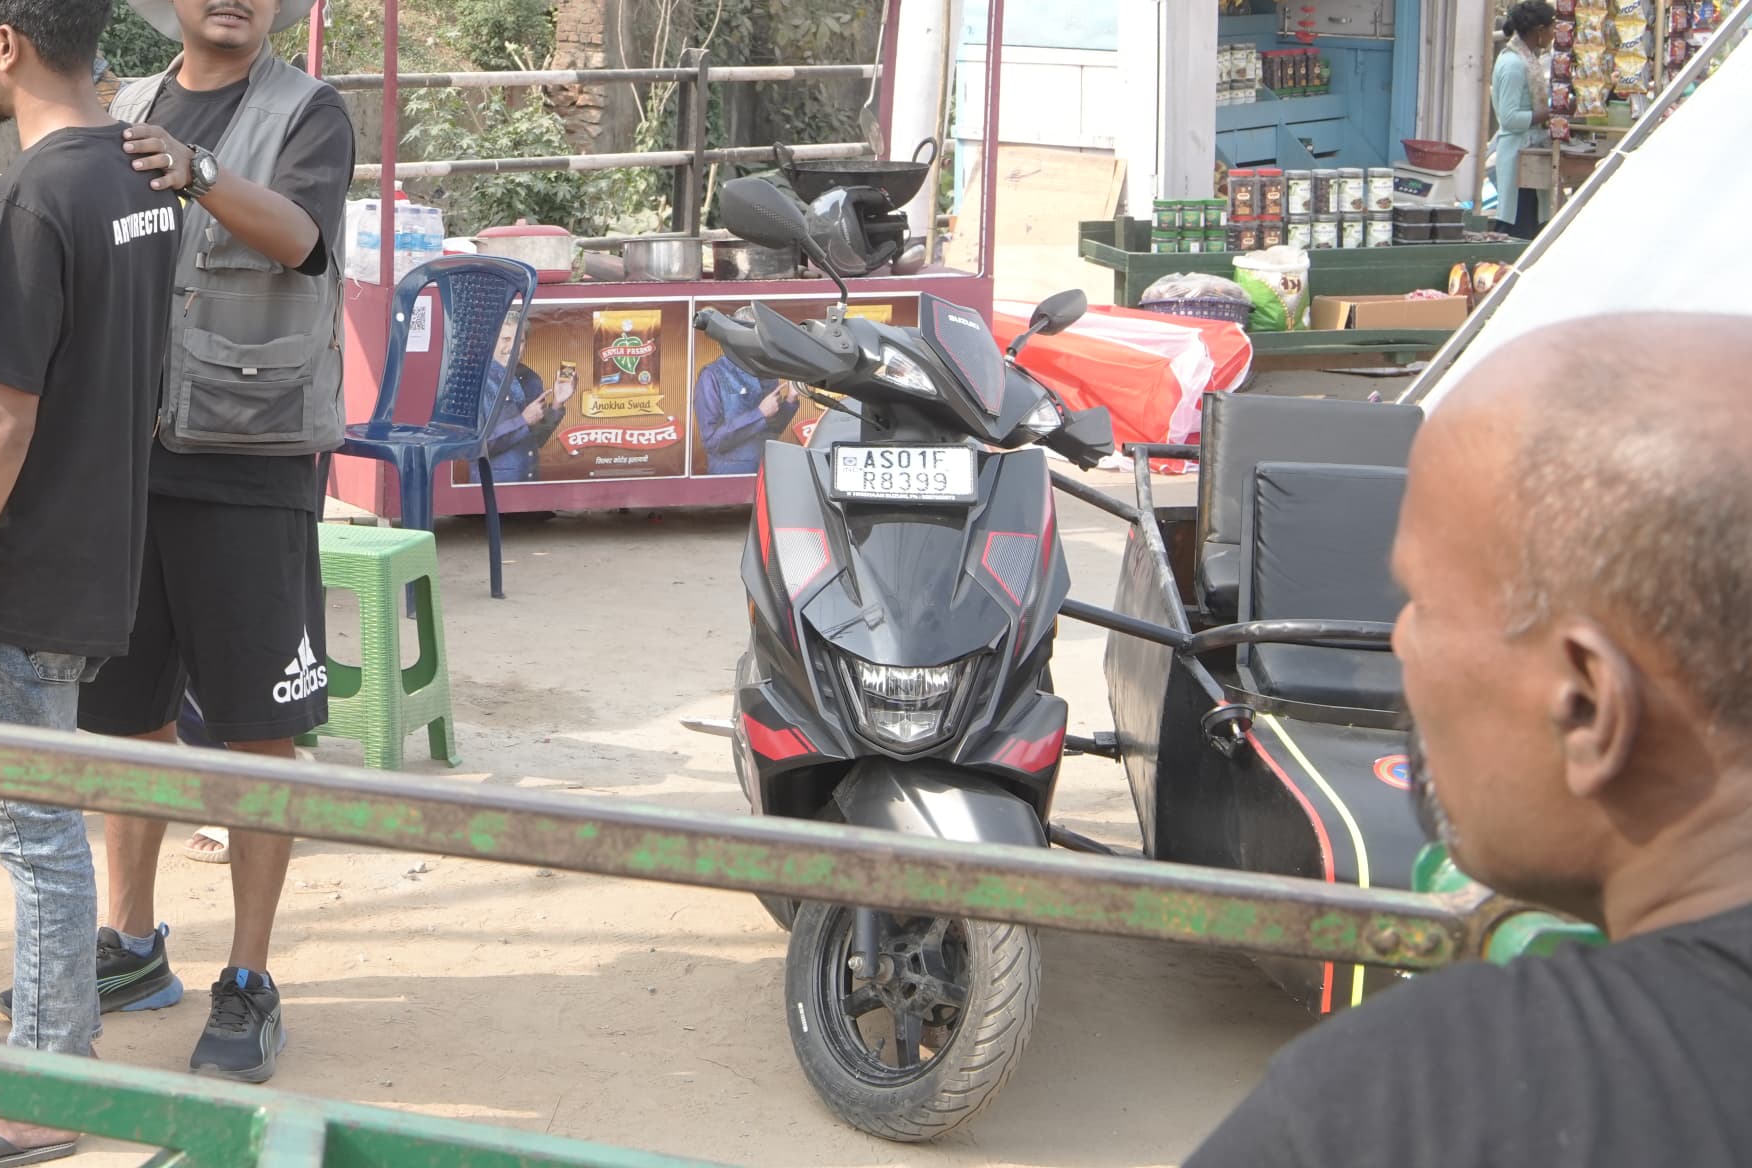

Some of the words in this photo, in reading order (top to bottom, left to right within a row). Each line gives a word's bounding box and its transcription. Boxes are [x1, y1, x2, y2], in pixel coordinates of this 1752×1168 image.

[591, 399, 625, 411] Anokha
[628, 399, 651, 410] Swad
[568, 429, 623, 445] कमला
[625, 426, 678, 445] पसन्द
[864, 450, 946, 469] AS01F
[864, 472, 948, 492] R8399
